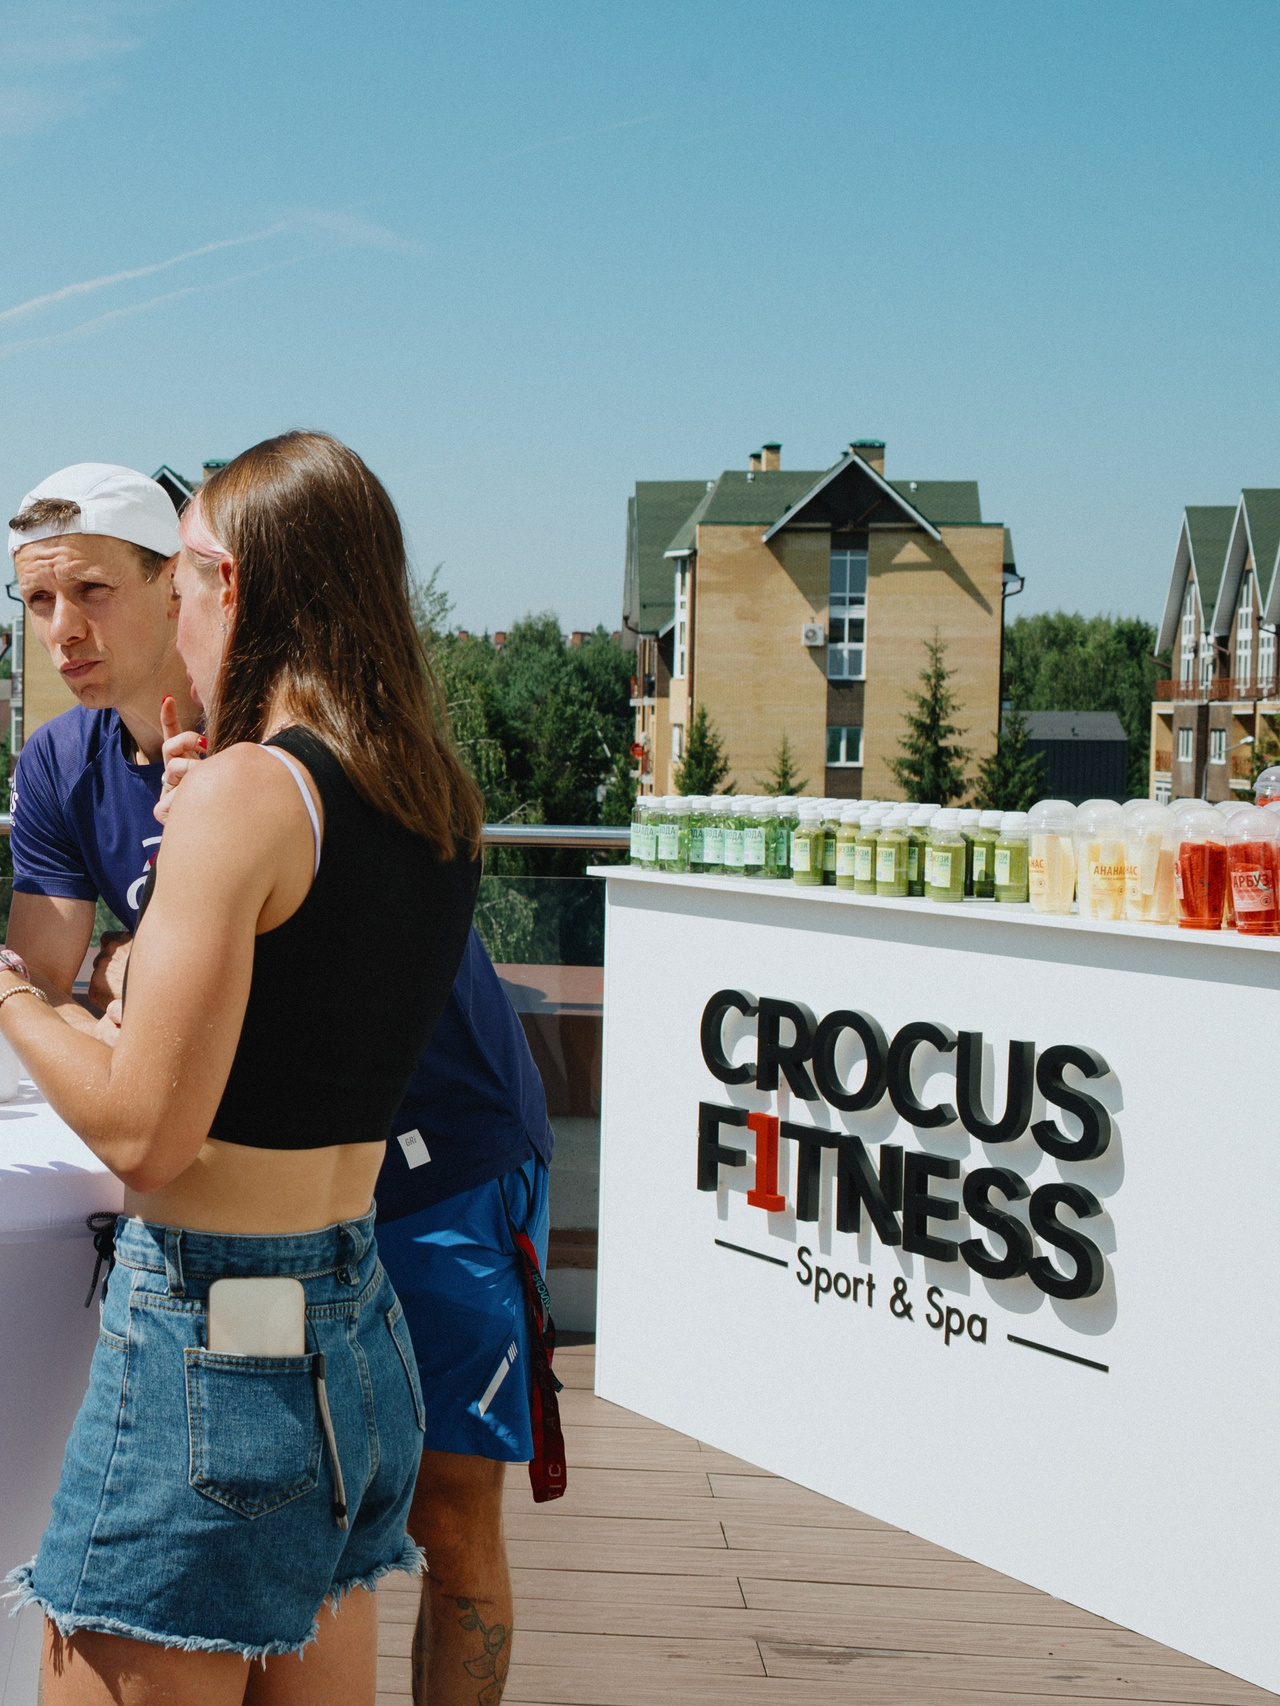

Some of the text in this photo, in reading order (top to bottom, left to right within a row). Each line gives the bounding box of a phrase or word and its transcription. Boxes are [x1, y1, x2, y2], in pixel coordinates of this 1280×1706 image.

[1233, 873, 1270, 888] АРБУЗ
[700, 989, 1112, 1162] CROCUS
[796, 1246, 988, 1346] Sport & Spa
